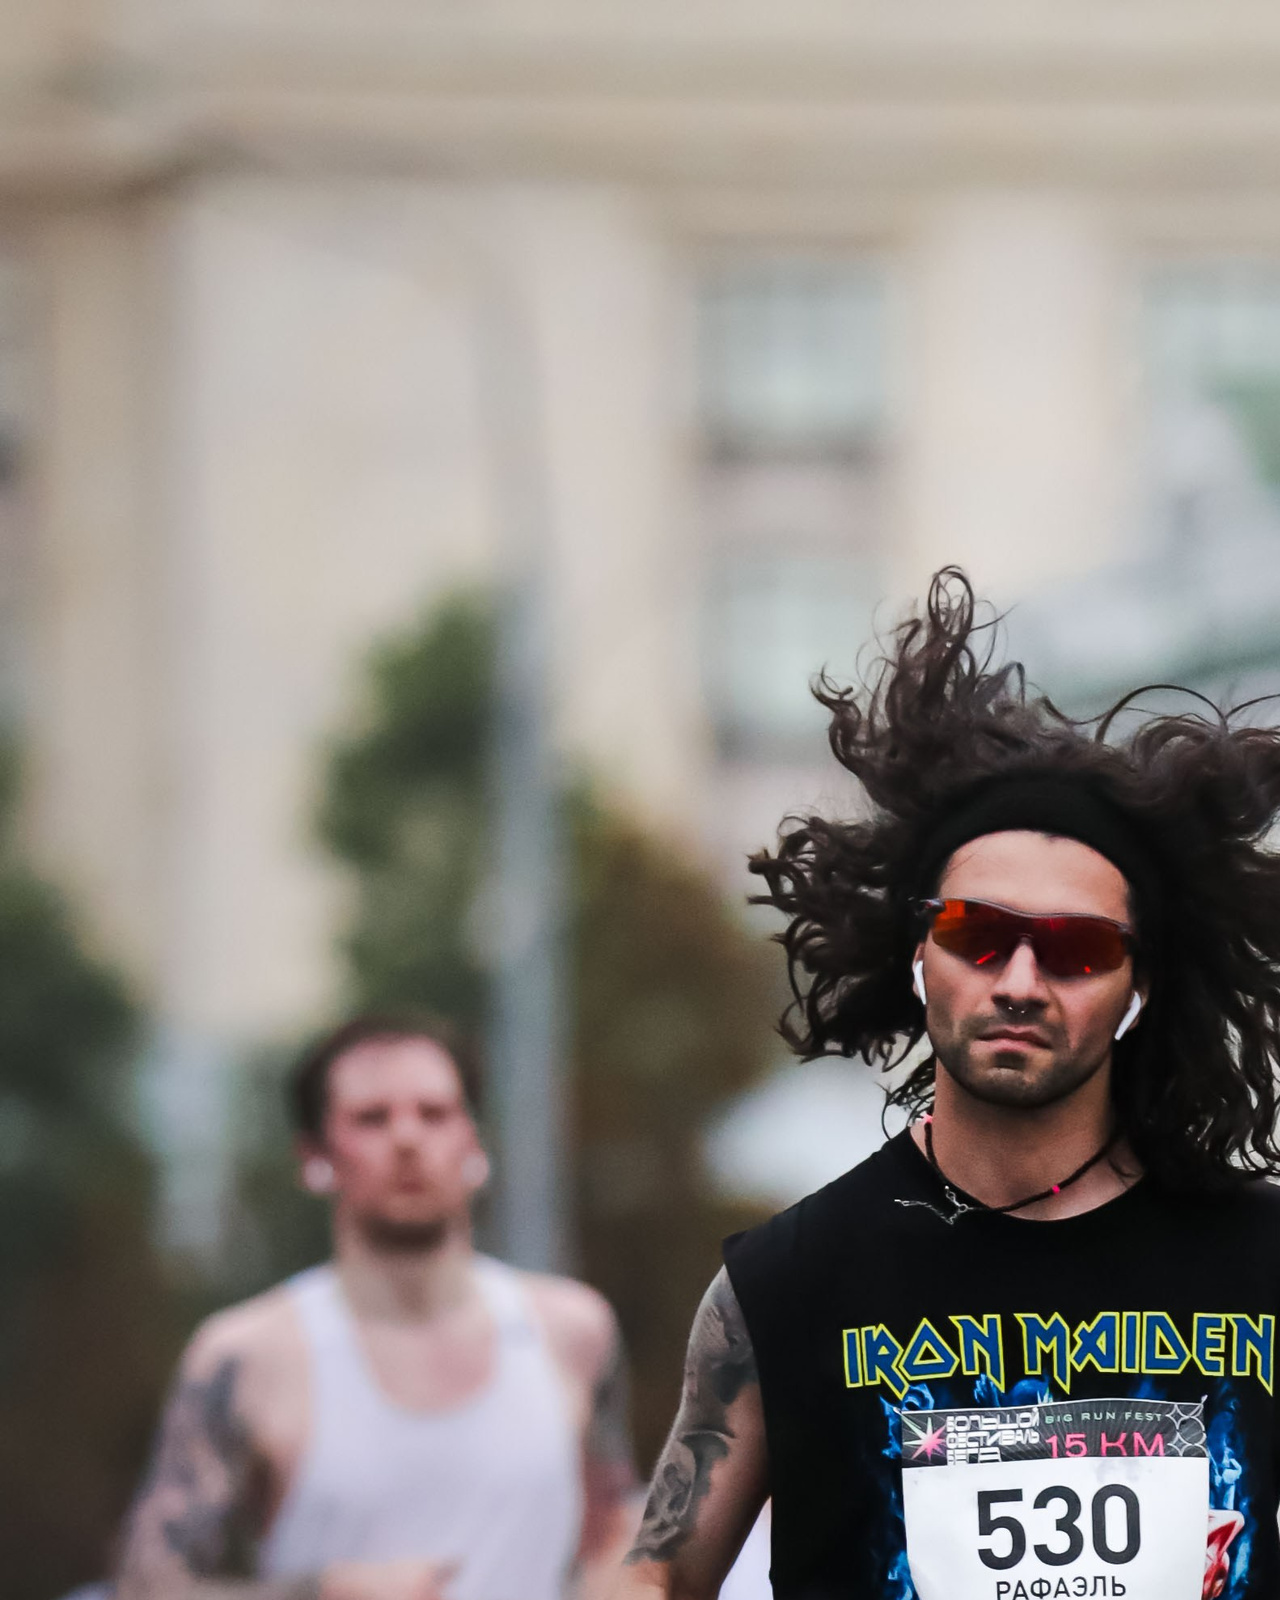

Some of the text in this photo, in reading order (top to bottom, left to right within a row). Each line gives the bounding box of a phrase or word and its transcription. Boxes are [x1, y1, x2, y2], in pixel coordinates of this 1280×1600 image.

[843, 1311, 1275, 1399] IRON MAIDEN
[1045, 1411, 1162, 1424] BIG RUN FEST
[1045, 1432, 1088, 1458] 15
[977, 1483, 1141, 1571] 530
